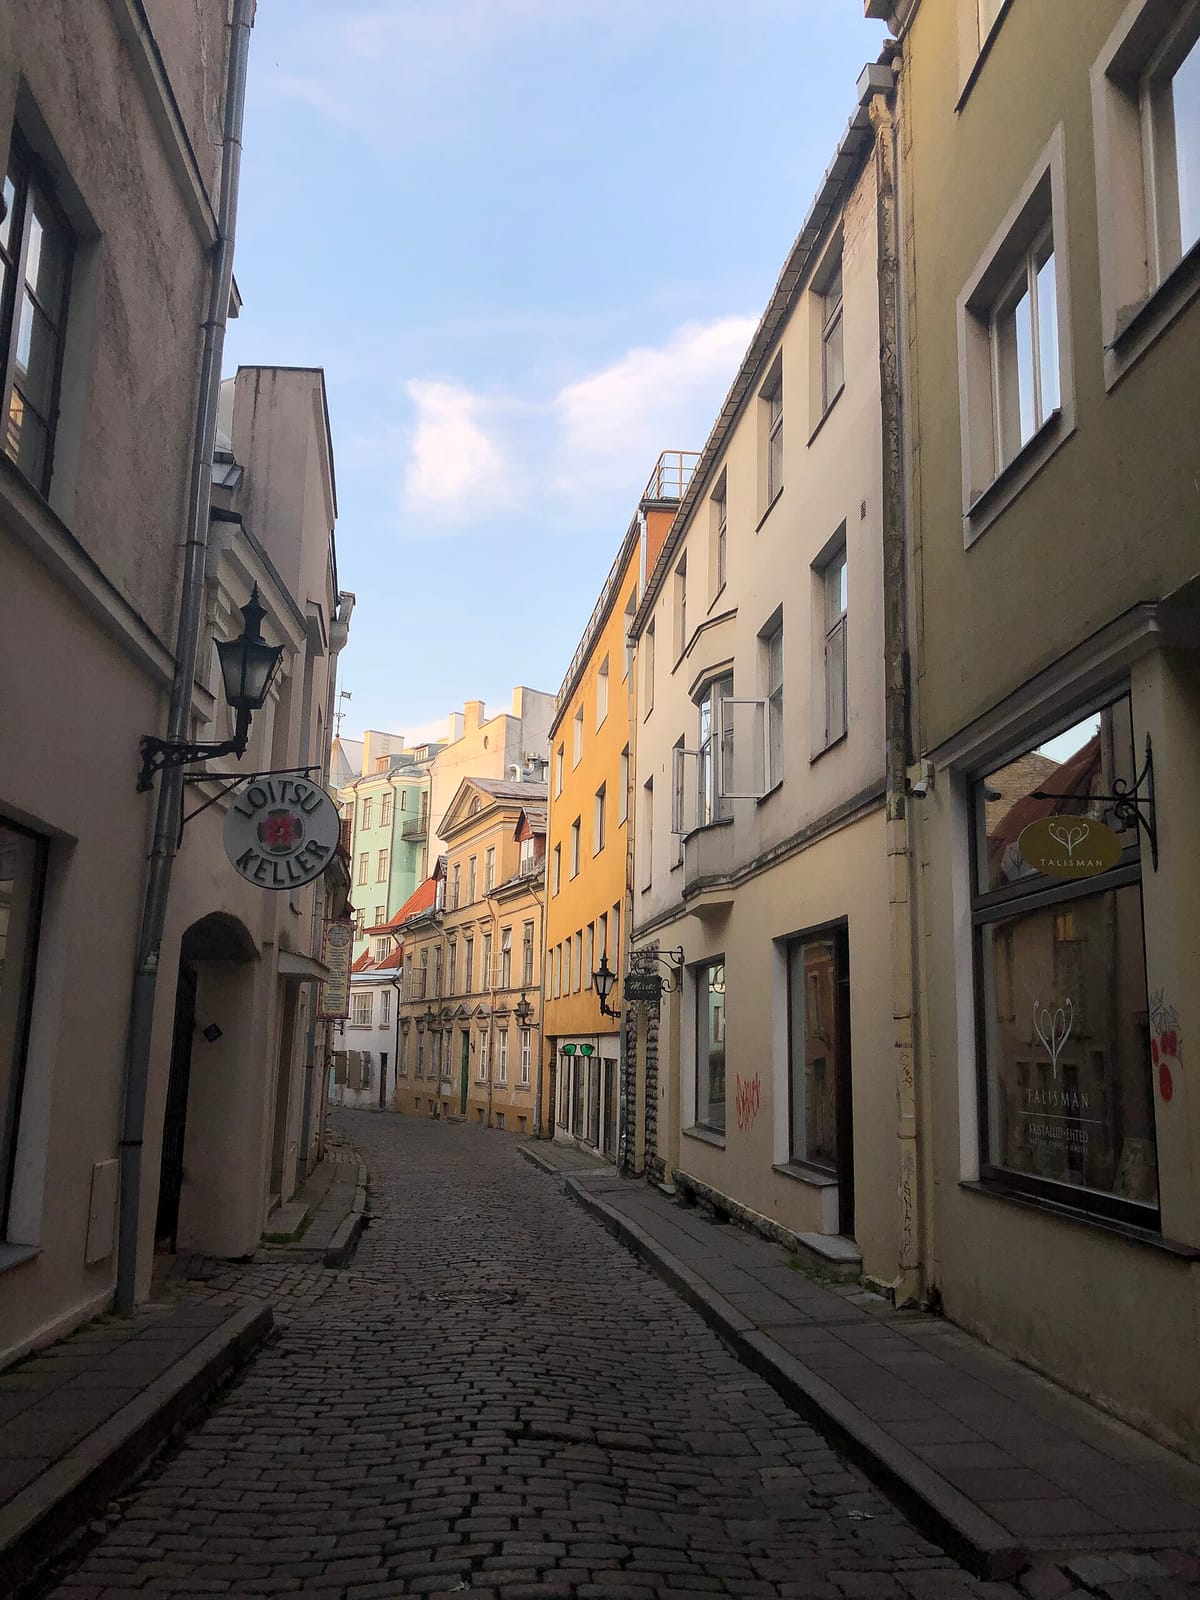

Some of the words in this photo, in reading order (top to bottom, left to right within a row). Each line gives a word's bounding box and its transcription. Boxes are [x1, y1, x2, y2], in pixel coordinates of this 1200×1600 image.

[234, 780, 323, 819] LOITSU
[236, 840, 330, 885] KELLER
[1040, 858, 1103, 867] TALISMAN
[1027, 1088, 1089, 1109] TALISMAN
